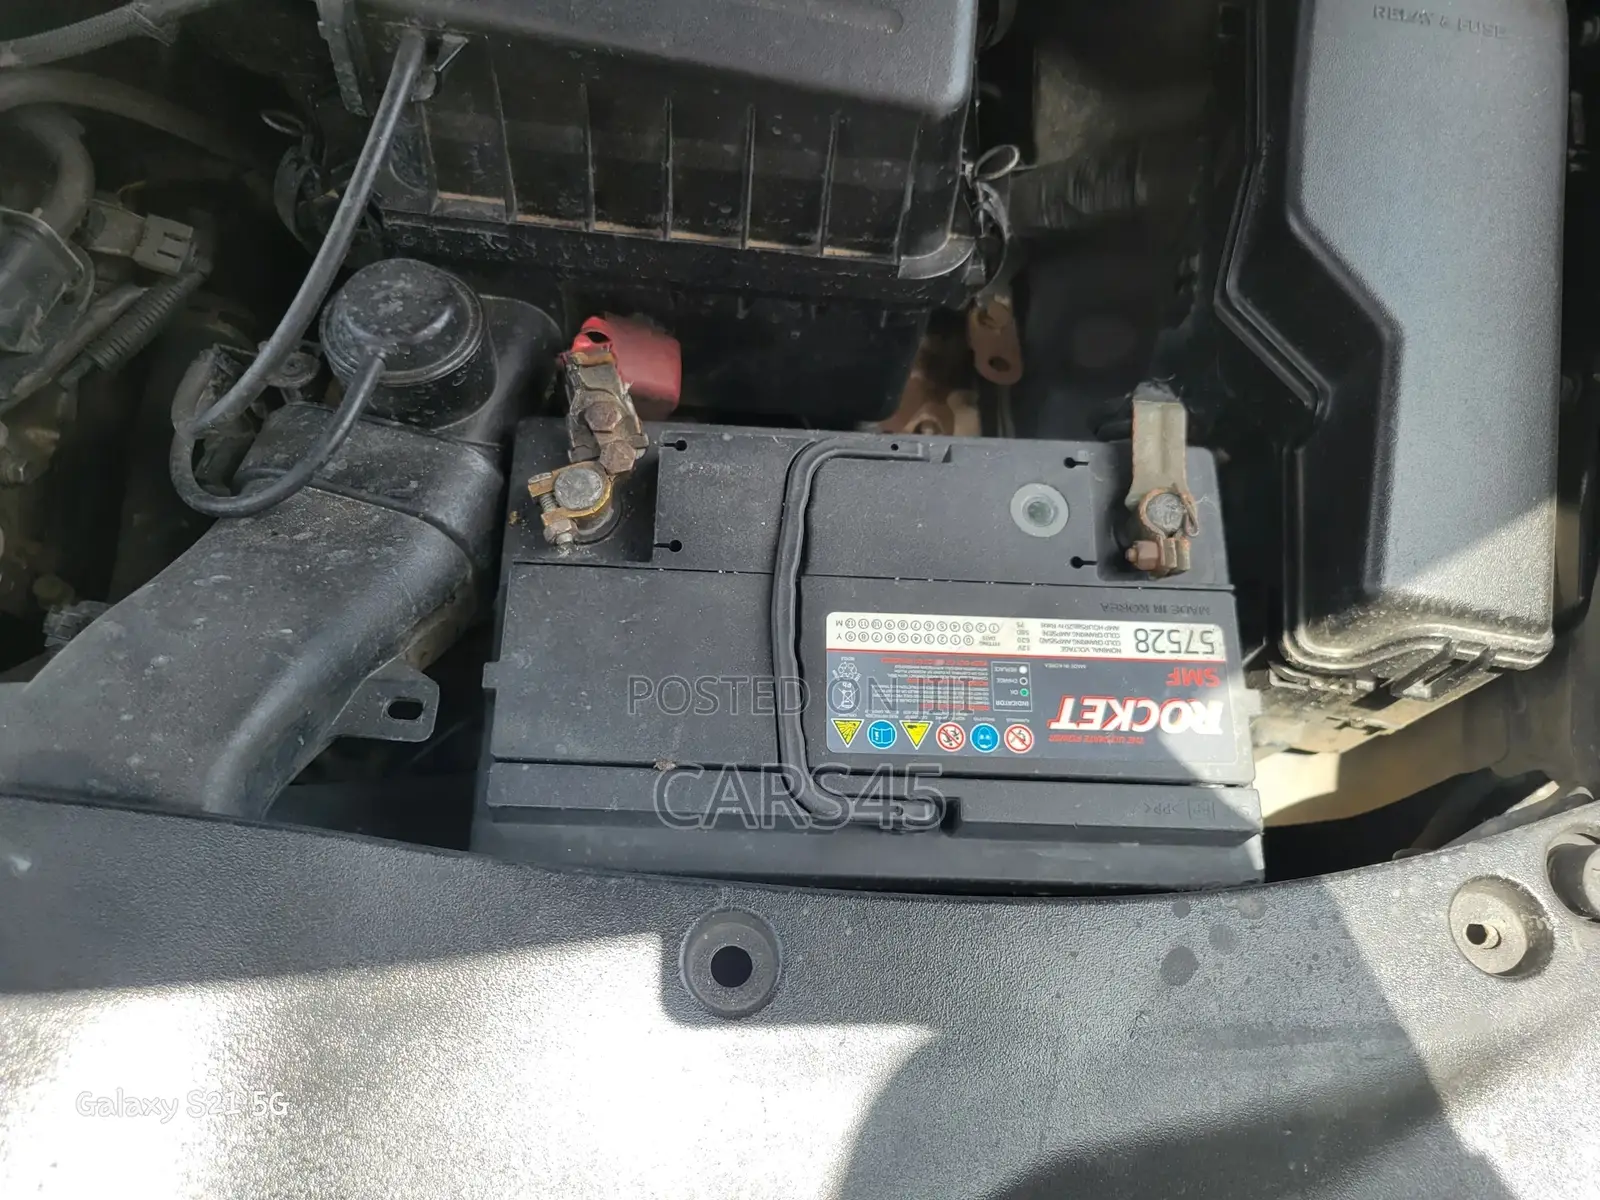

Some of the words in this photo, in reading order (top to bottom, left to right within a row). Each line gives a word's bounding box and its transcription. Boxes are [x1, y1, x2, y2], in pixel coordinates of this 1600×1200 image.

[1372, 4, 1433, 26] RELAY
[1457, 17, 1509, 39] FUSE
[1100, 603, 1150, 614] KOREA
[1153, 604, 1166, 614] IN
[1170, 606, 1210, 616] MADE
[836, 632, 843, 640] Y
[1132, 628, 1216, 656] 57528
[1166, 667, 1220, 688] SMF
[1046, 695, 1224, 735] ROCKET
